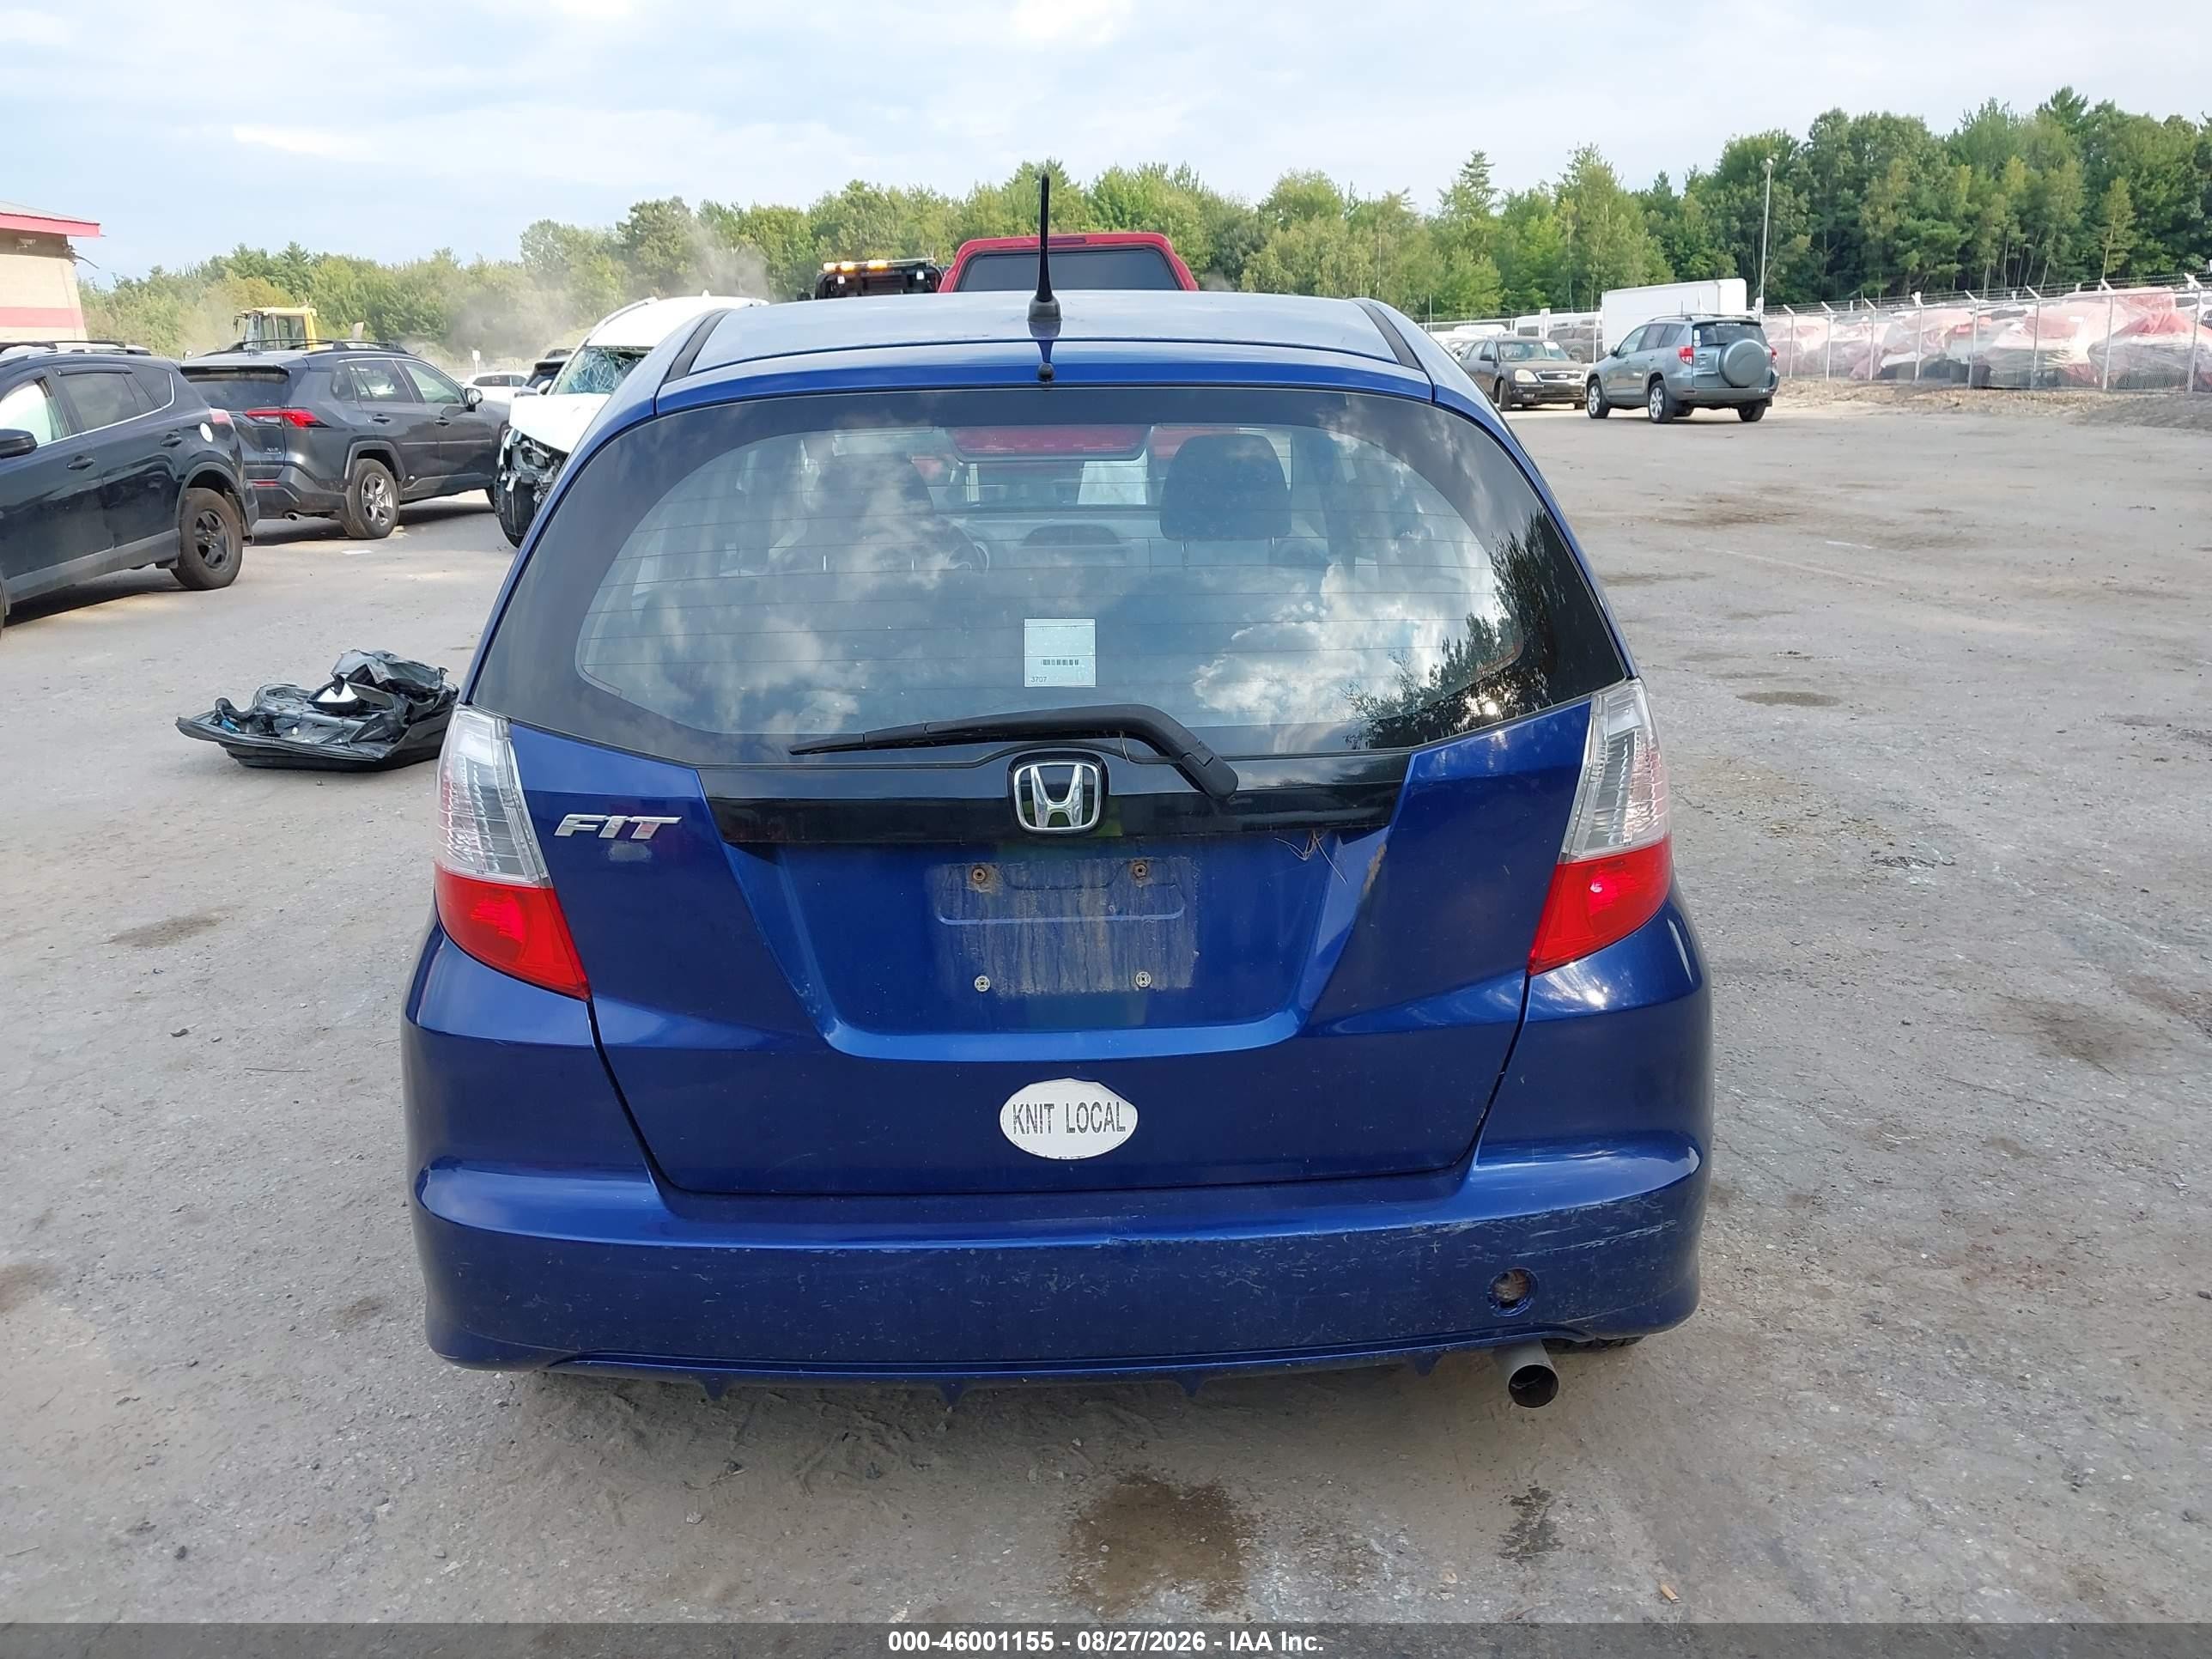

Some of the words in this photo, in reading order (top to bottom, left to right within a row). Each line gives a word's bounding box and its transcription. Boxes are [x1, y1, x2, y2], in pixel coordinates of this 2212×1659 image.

[554, 814, 683, 839] FIT
[1012, 1103, 1054, 1135] KNIT
[1066, 1101, 1127, 1133] LOCAL
